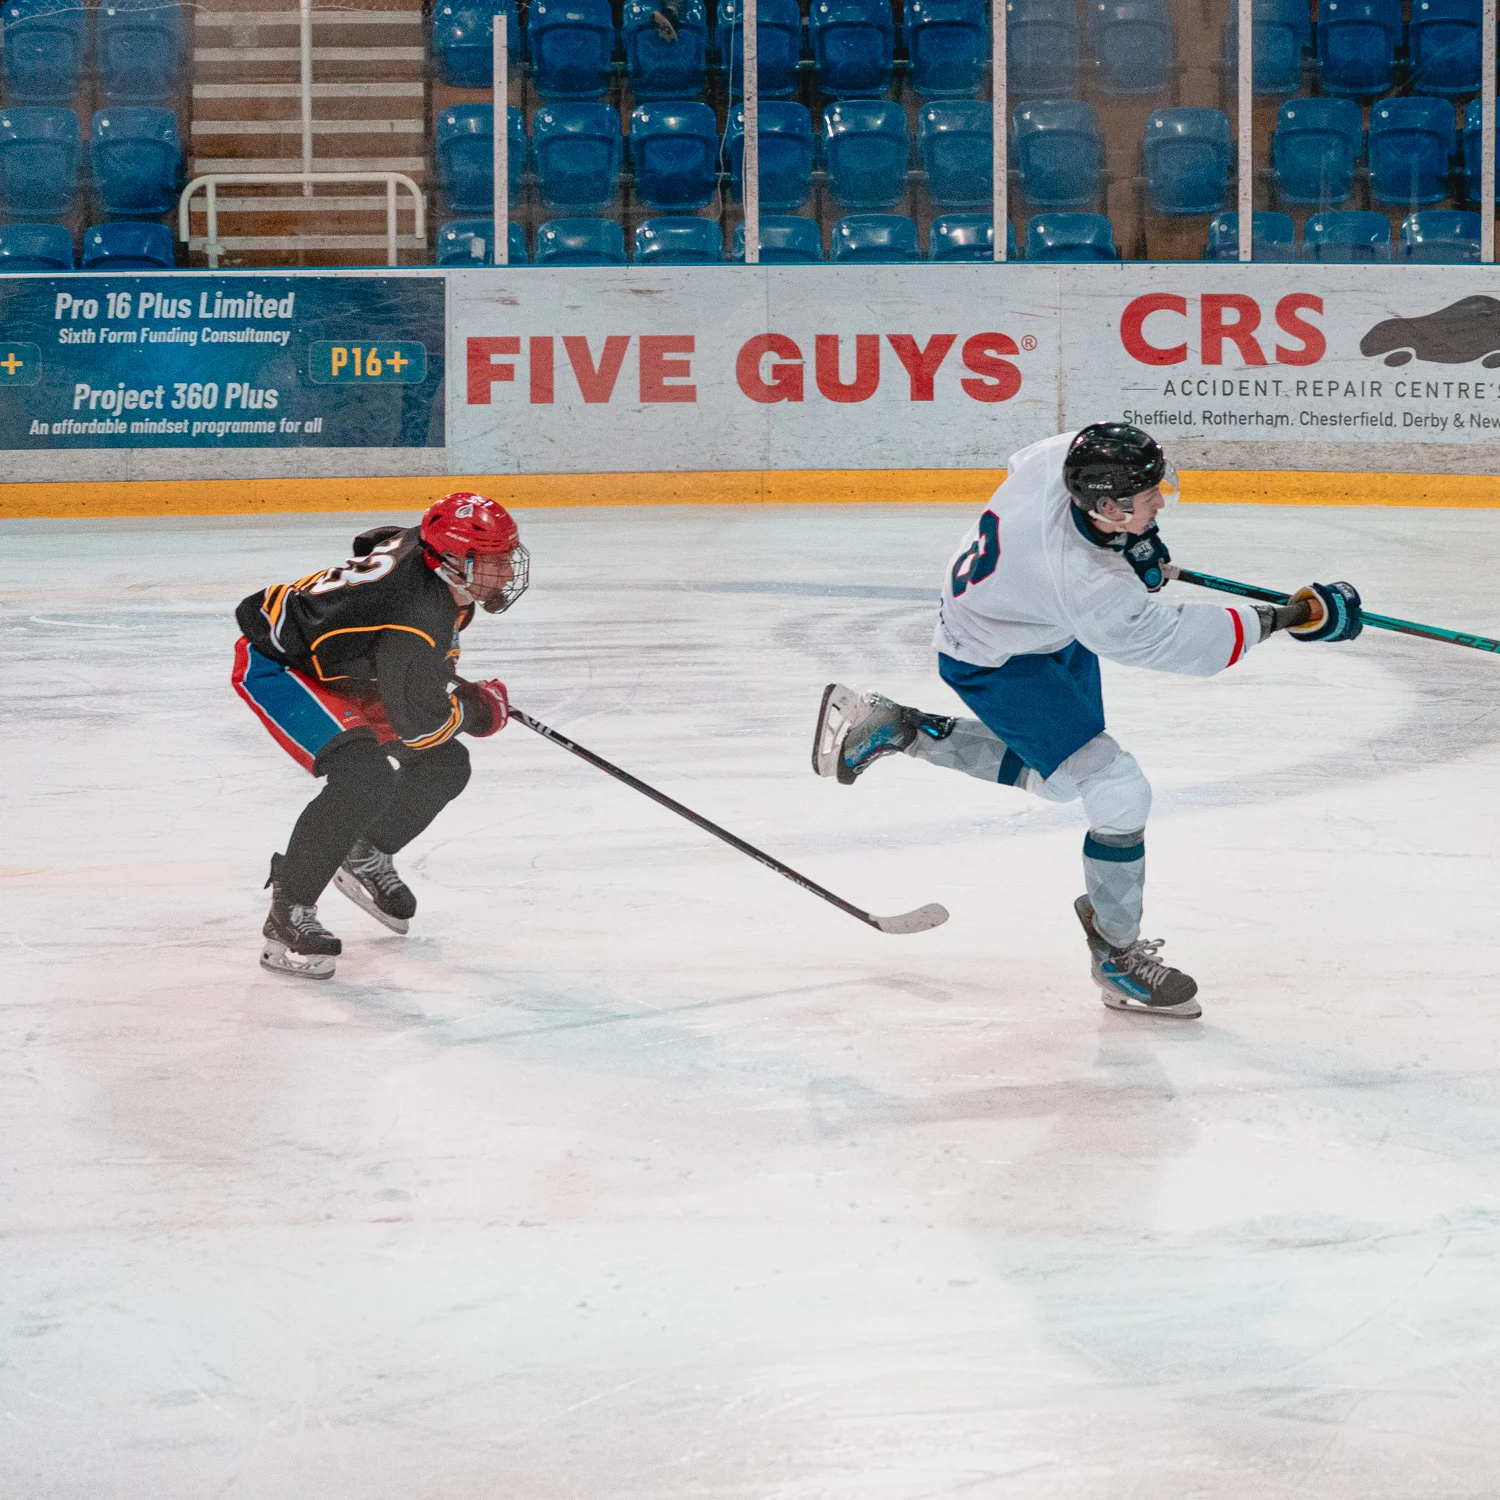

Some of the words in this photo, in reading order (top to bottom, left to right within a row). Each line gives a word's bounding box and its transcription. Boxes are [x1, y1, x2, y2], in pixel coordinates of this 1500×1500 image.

[54, 293, 98, 320] Pro
[106, 293, 131, 319] 16
[138, 292, 192, 319] Plus
[199, 291, 296, 319] Limited
[58, 328, 96, 344] Sixth
[100, 327, 137, 344] Form
[141, 327, 198, 347] Funding
[201, 327, 291, 347] Consultancy
[1120, 293, 1327, 366] CRS
[331, 346, 409, 377] P16+
[466, 335, 697, 404] FIVE
[73, 382, 165, 416] Project
[171, 382, 218, 409] 360
[225, 382, 279, 409] Plus
[1163, 380, 1283, 397] ACCIDENT
[1296, 380, 1383, 398] REPAIR
[29, 420, 49, 435] An
[52, 418, 127, 435] affordable
[130, 418, 189, 434] mindset
[192, 421, 275, 438] programme
[279, 418, 302, 433] for
[304, 417, 323, 433] all
[1122, 410, 1197, 428] Sheffield,
[1202, 411, 1294, 428] Rotherham,
[1300, 411, 1397, 429] Chesterfield,
[1403, 411, 1449, 432] Derby
[1453, 412, 1465, 428] &
